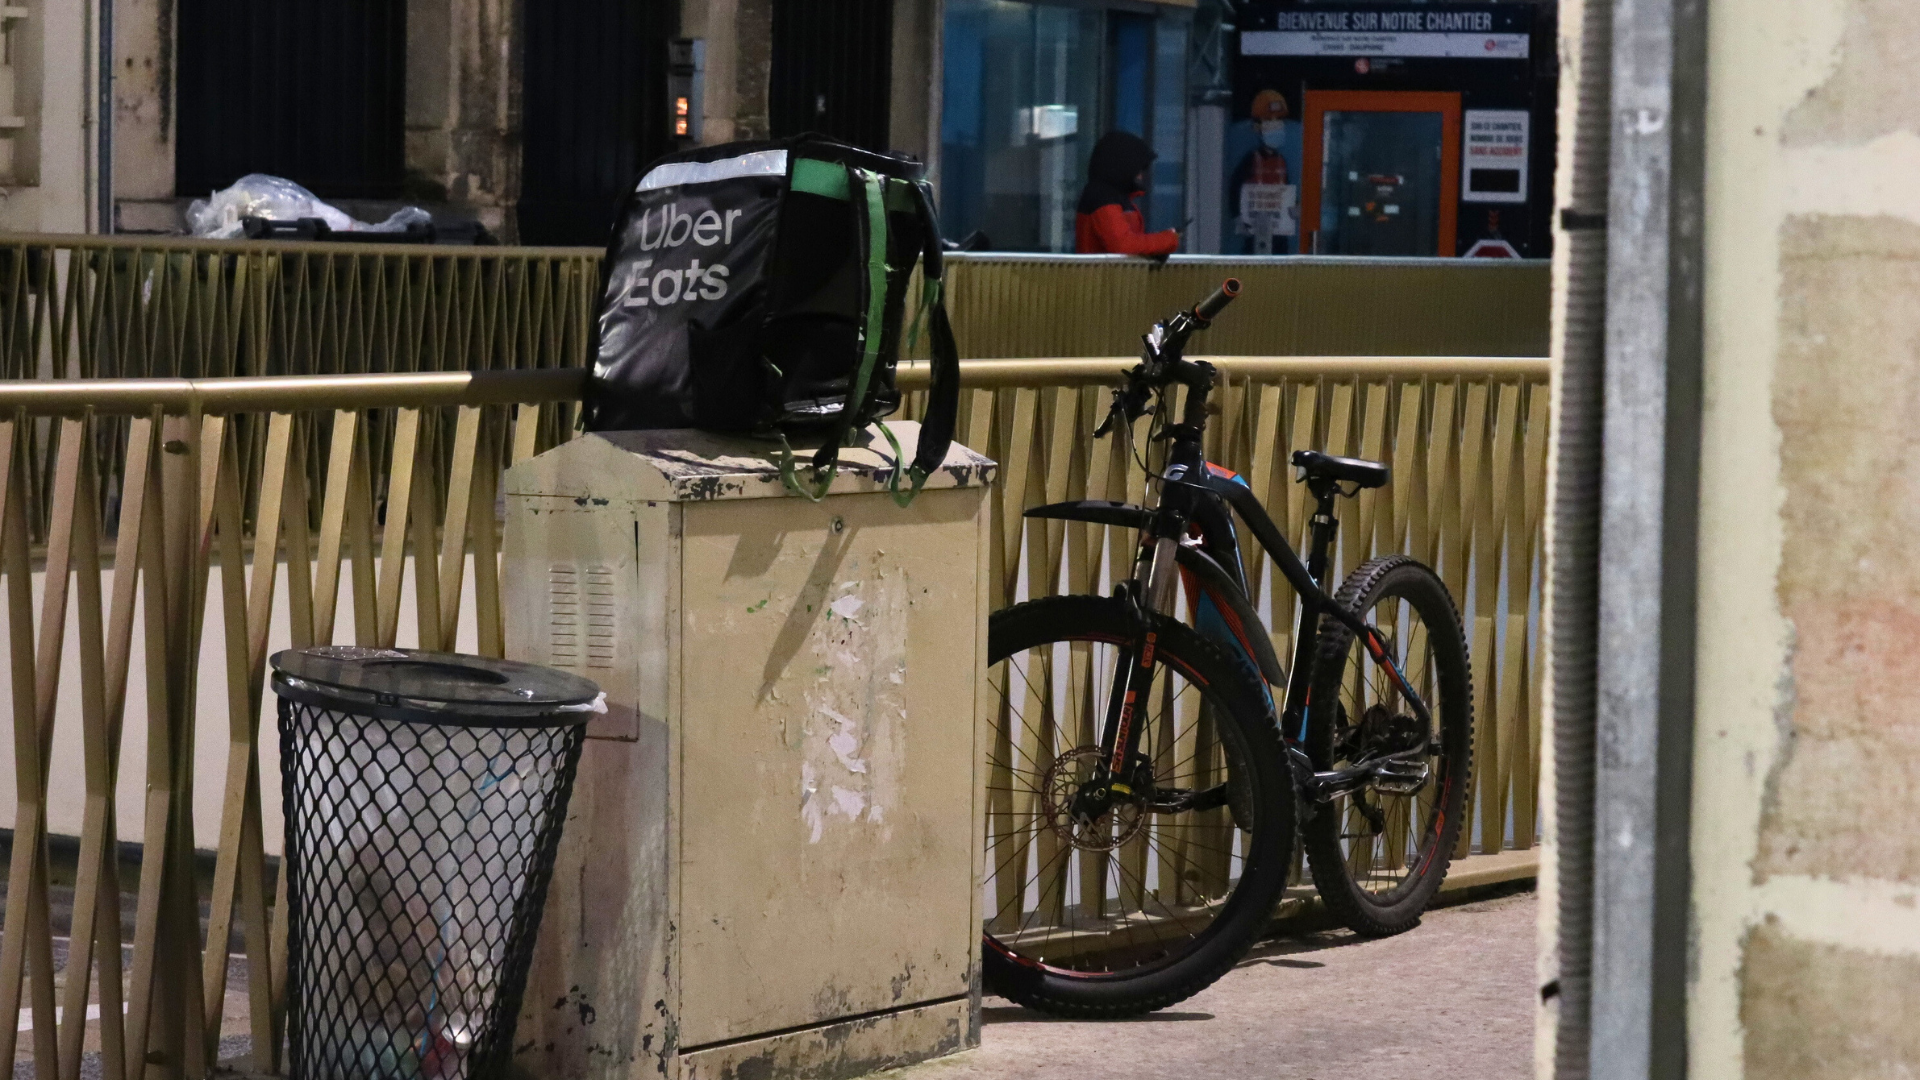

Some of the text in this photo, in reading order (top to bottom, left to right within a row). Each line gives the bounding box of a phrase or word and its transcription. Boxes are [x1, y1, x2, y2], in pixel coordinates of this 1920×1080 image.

[1278, 11, 1492, 32] BIENVENUE SUR NOTRE CHANTIER
[640, 203, 742, 251] Uber
[623, 259, 730, 307] Eats
